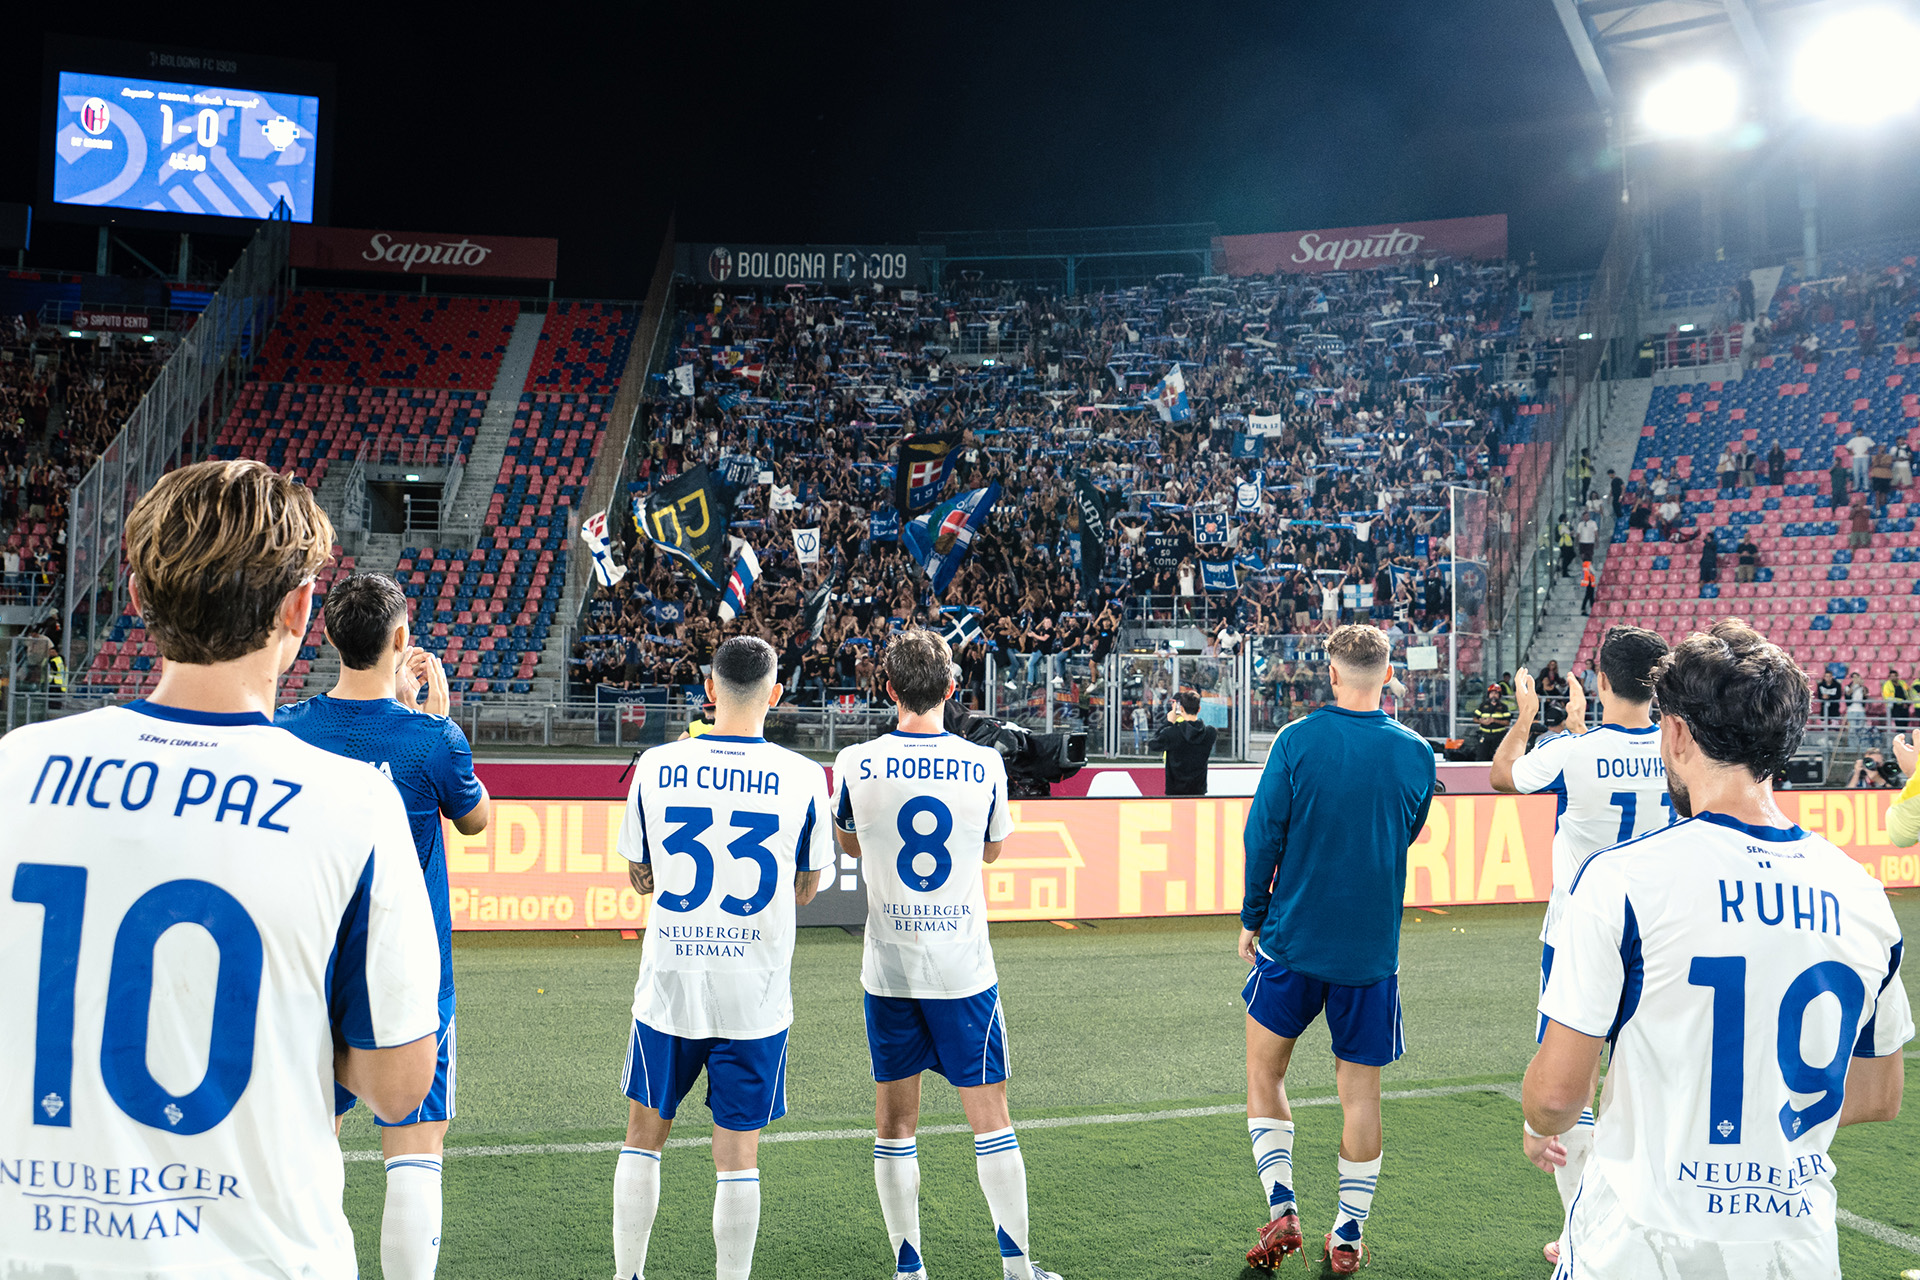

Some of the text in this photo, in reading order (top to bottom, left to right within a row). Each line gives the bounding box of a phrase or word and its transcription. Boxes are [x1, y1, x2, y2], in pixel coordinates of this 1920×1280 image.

[159, 56, 237, 73] BOLOGNA FC 1909
[362, 232, 491, 272] Saputo
[737, 251, 826, 278] BOLOGNA
[833, 252, 857, 279] FC
[1291, 227, 1425, 270] Saputo
[90, 314, 149, 329] SAPUTO CENTO
[1154, 537, 1179, 547] OVER
[1153, 557, 1178, 566] COMO
[617, 696, 646, 704] COMO
[659, 764, 780, 796] DA CUNHA
[860, 757, 985, 784] S. ROBERTO
[29, 755, 303, 834] NICO PAZ
[1798, 793, 1903, 847] EDIL
[656, 806, 780, 917] 33
[896, 795, 954, 892] 8
[1404, 798, 1535, 904] RIA
[450, 886, 575, 922] Pianoro
[883, 903, 971, 917] NEUBERGER
[1718, 860, 1841, 937] KÜHN
[659, 925, 762, 941] NEUBERGER
[894, 919, 958, 932] BERMAN
[675, 943, 745, 958] BERMAN
[12, 861, 264, 1136] 10
[1687, 955, 1866, 1145] 19
[0, 1158, 244, 1200] NEUBERGER
[1676, 1153, 1828, 1189] NEUBERER
[33, 1203, 204, 1241] BERMAN
